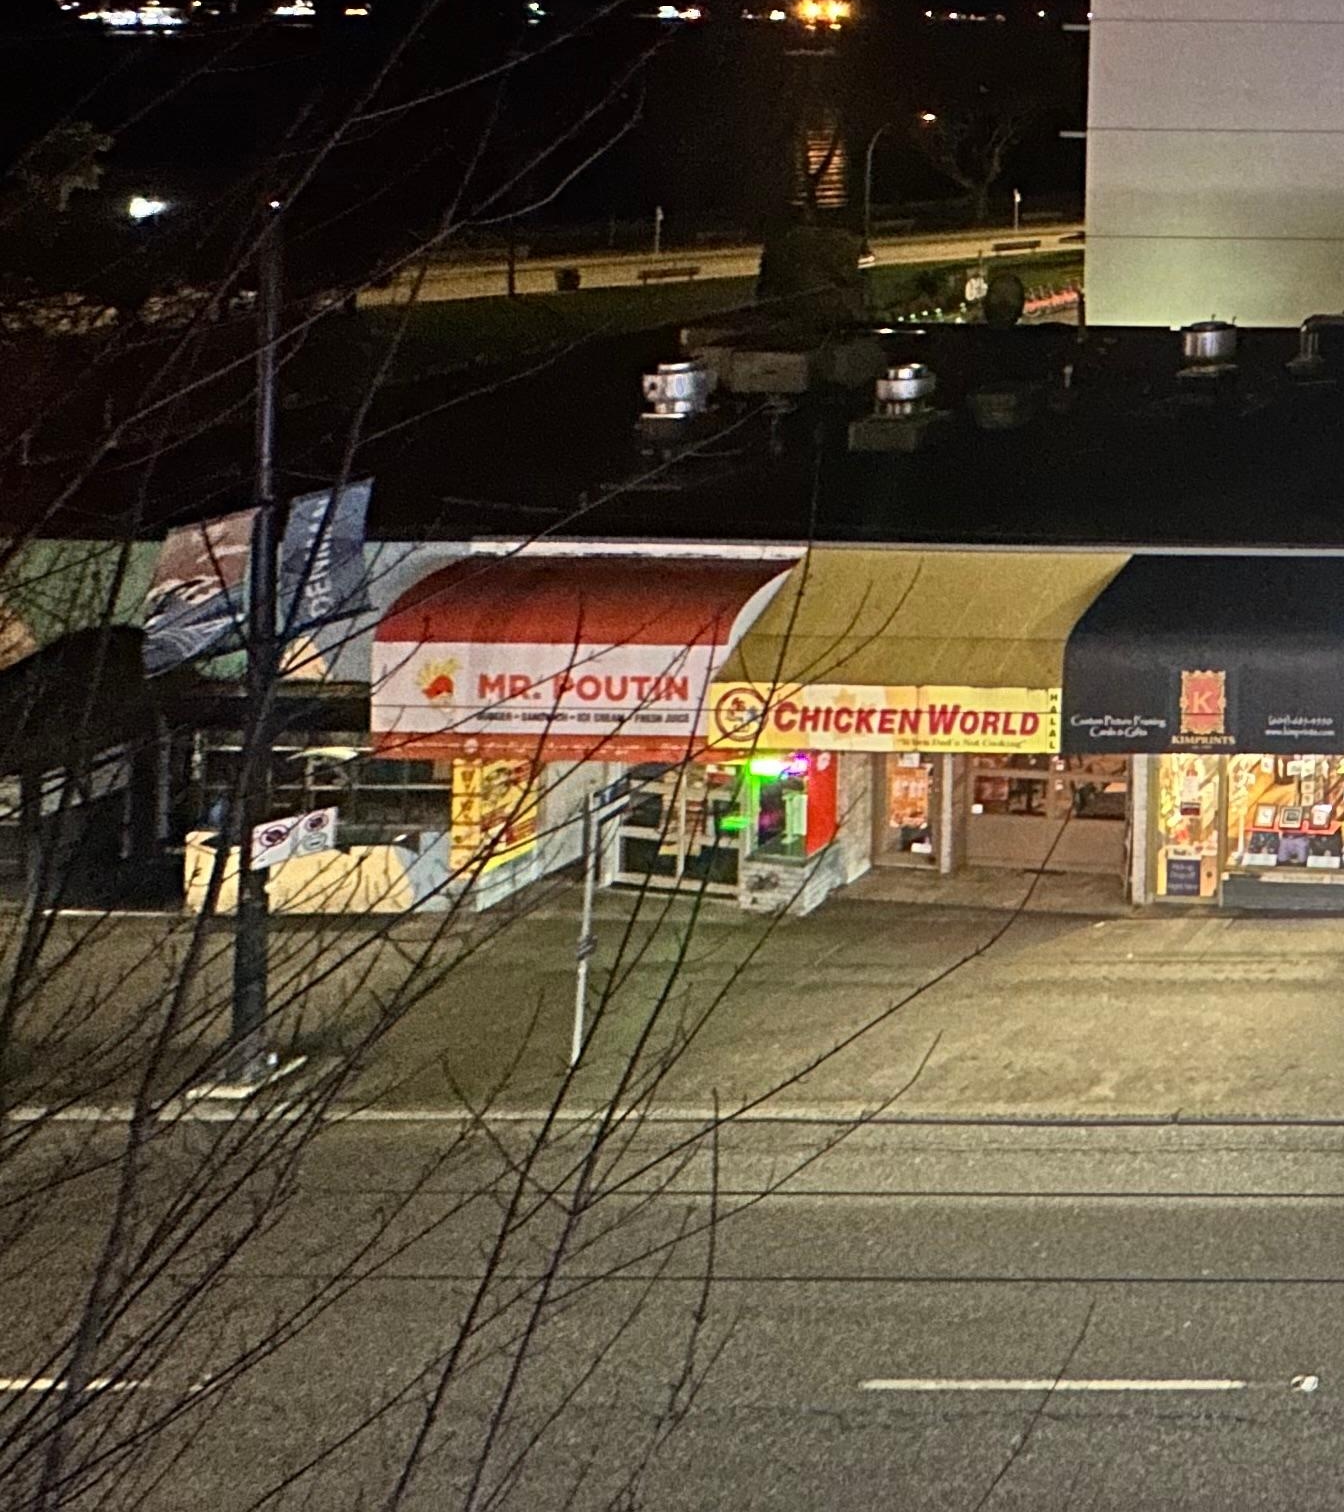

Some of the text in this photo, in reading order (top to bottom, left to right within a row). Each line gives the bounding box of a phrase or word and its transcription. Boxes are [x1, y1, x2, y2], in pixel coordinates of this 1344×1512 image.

[478, 673, 689, 701] MR. POUTIN
[1192, 691, 1214, 714] K
[774, 701, 1040, 736] CHICKEN WORLD
[1049, 694, 1058, 749] HALAL
[1171, 735, 1236, 745] KIMPRINTS
